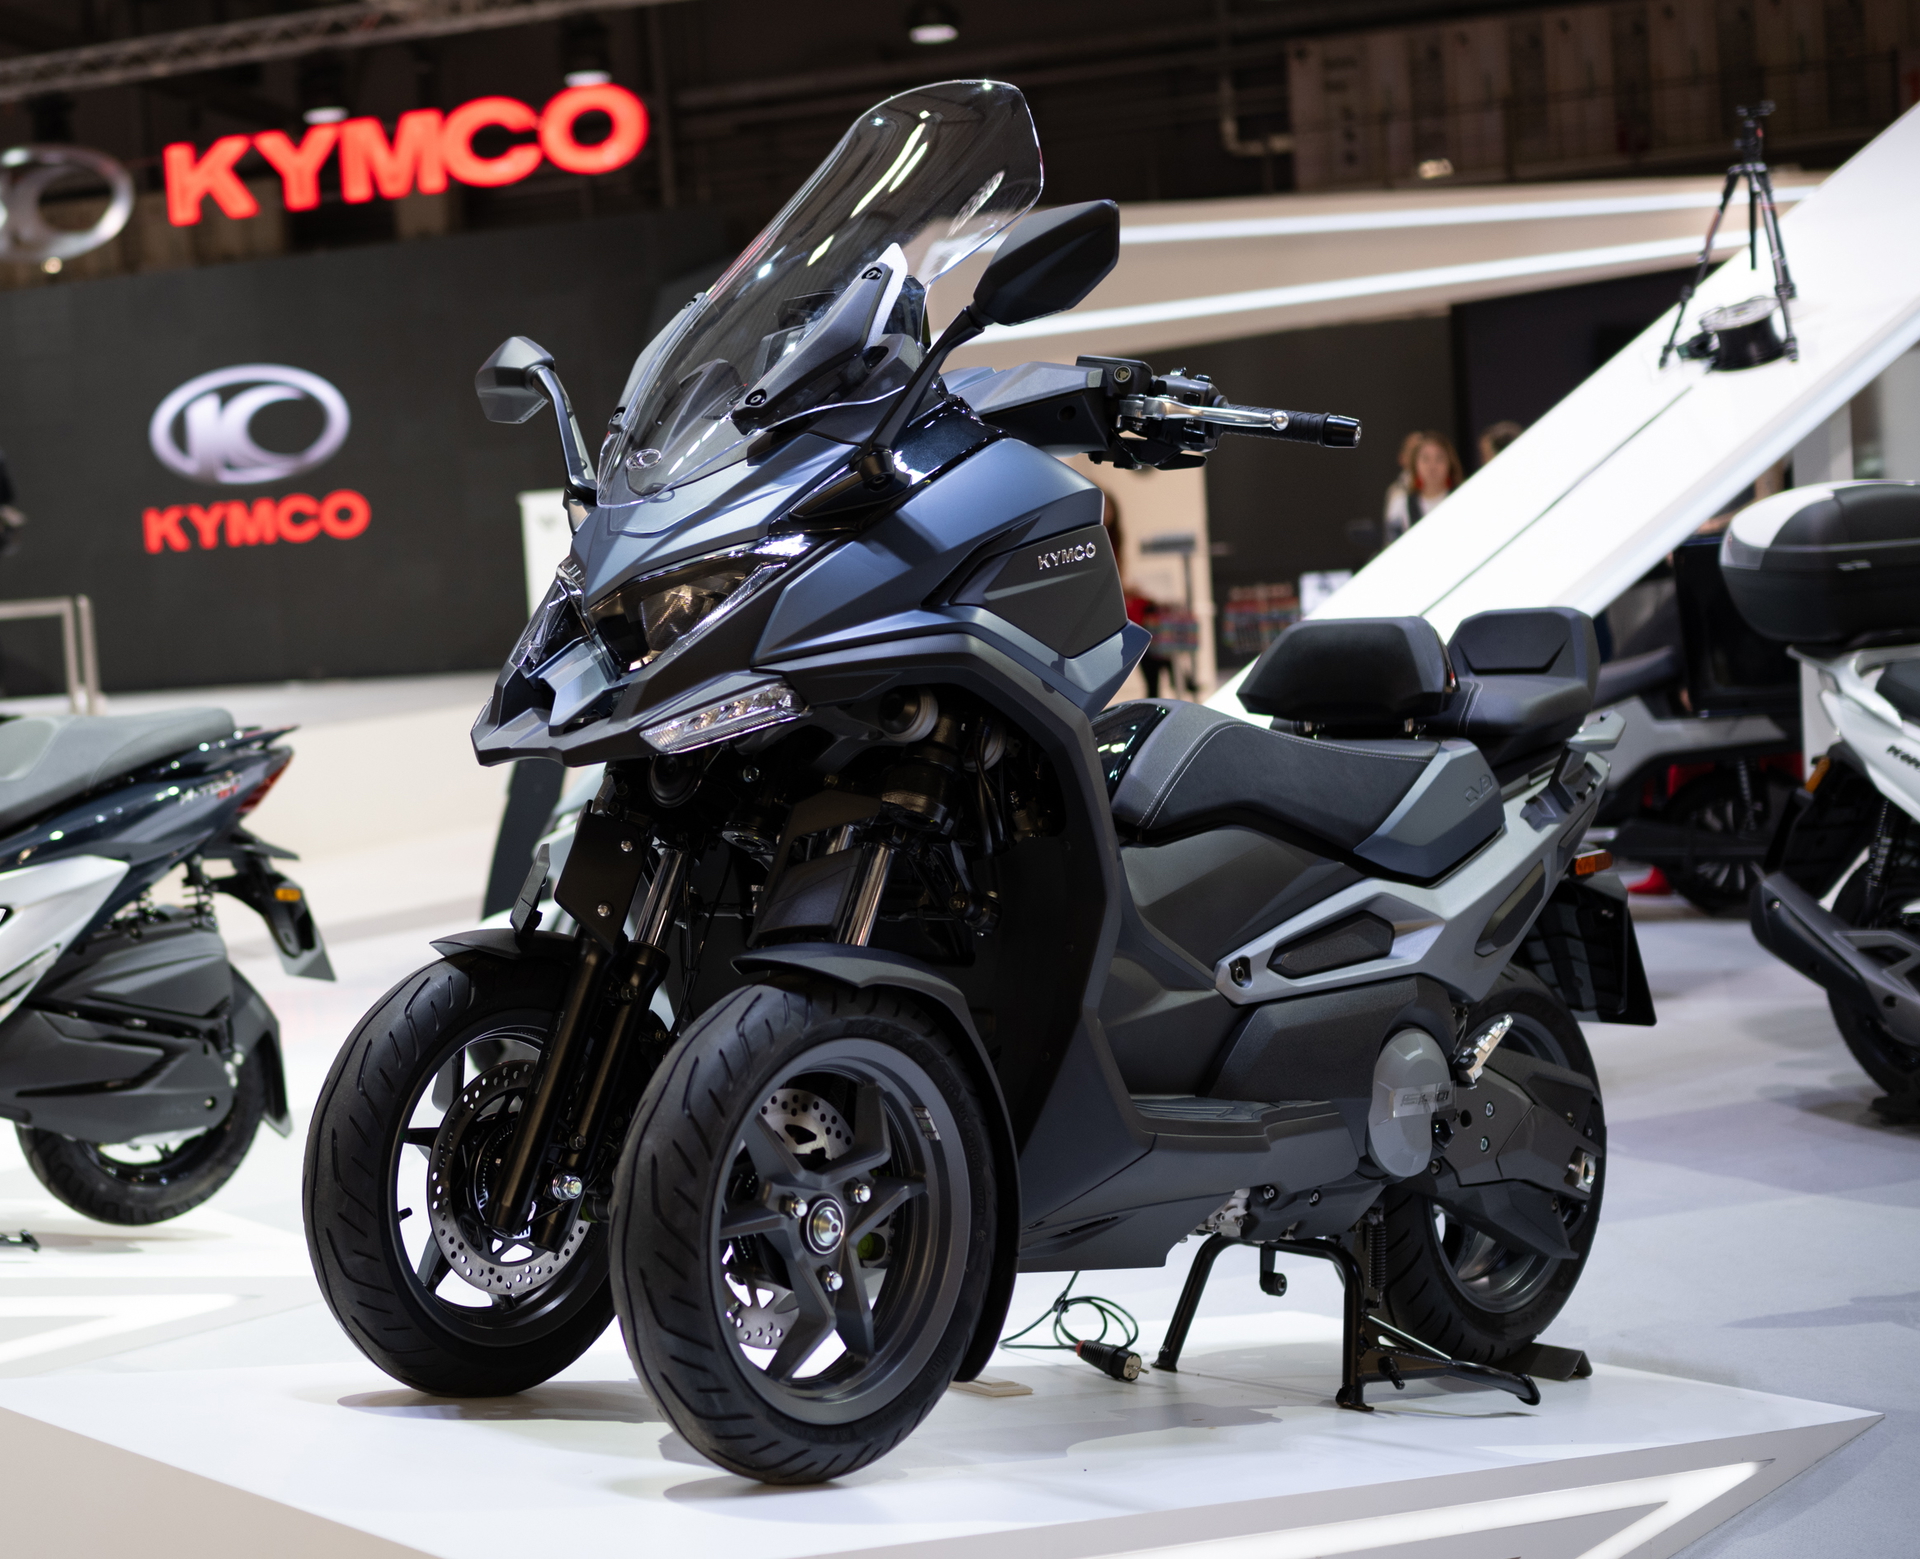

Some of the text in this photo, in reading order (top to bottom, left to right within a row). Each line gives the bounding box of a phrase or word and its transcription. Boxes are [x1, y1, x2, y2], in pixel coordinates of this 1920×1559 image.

[162, 83, 649, 227] KYMCO
[143, 490, 371, 553] KYMCO
[1037, 541, 1097, 570] KYMCO
